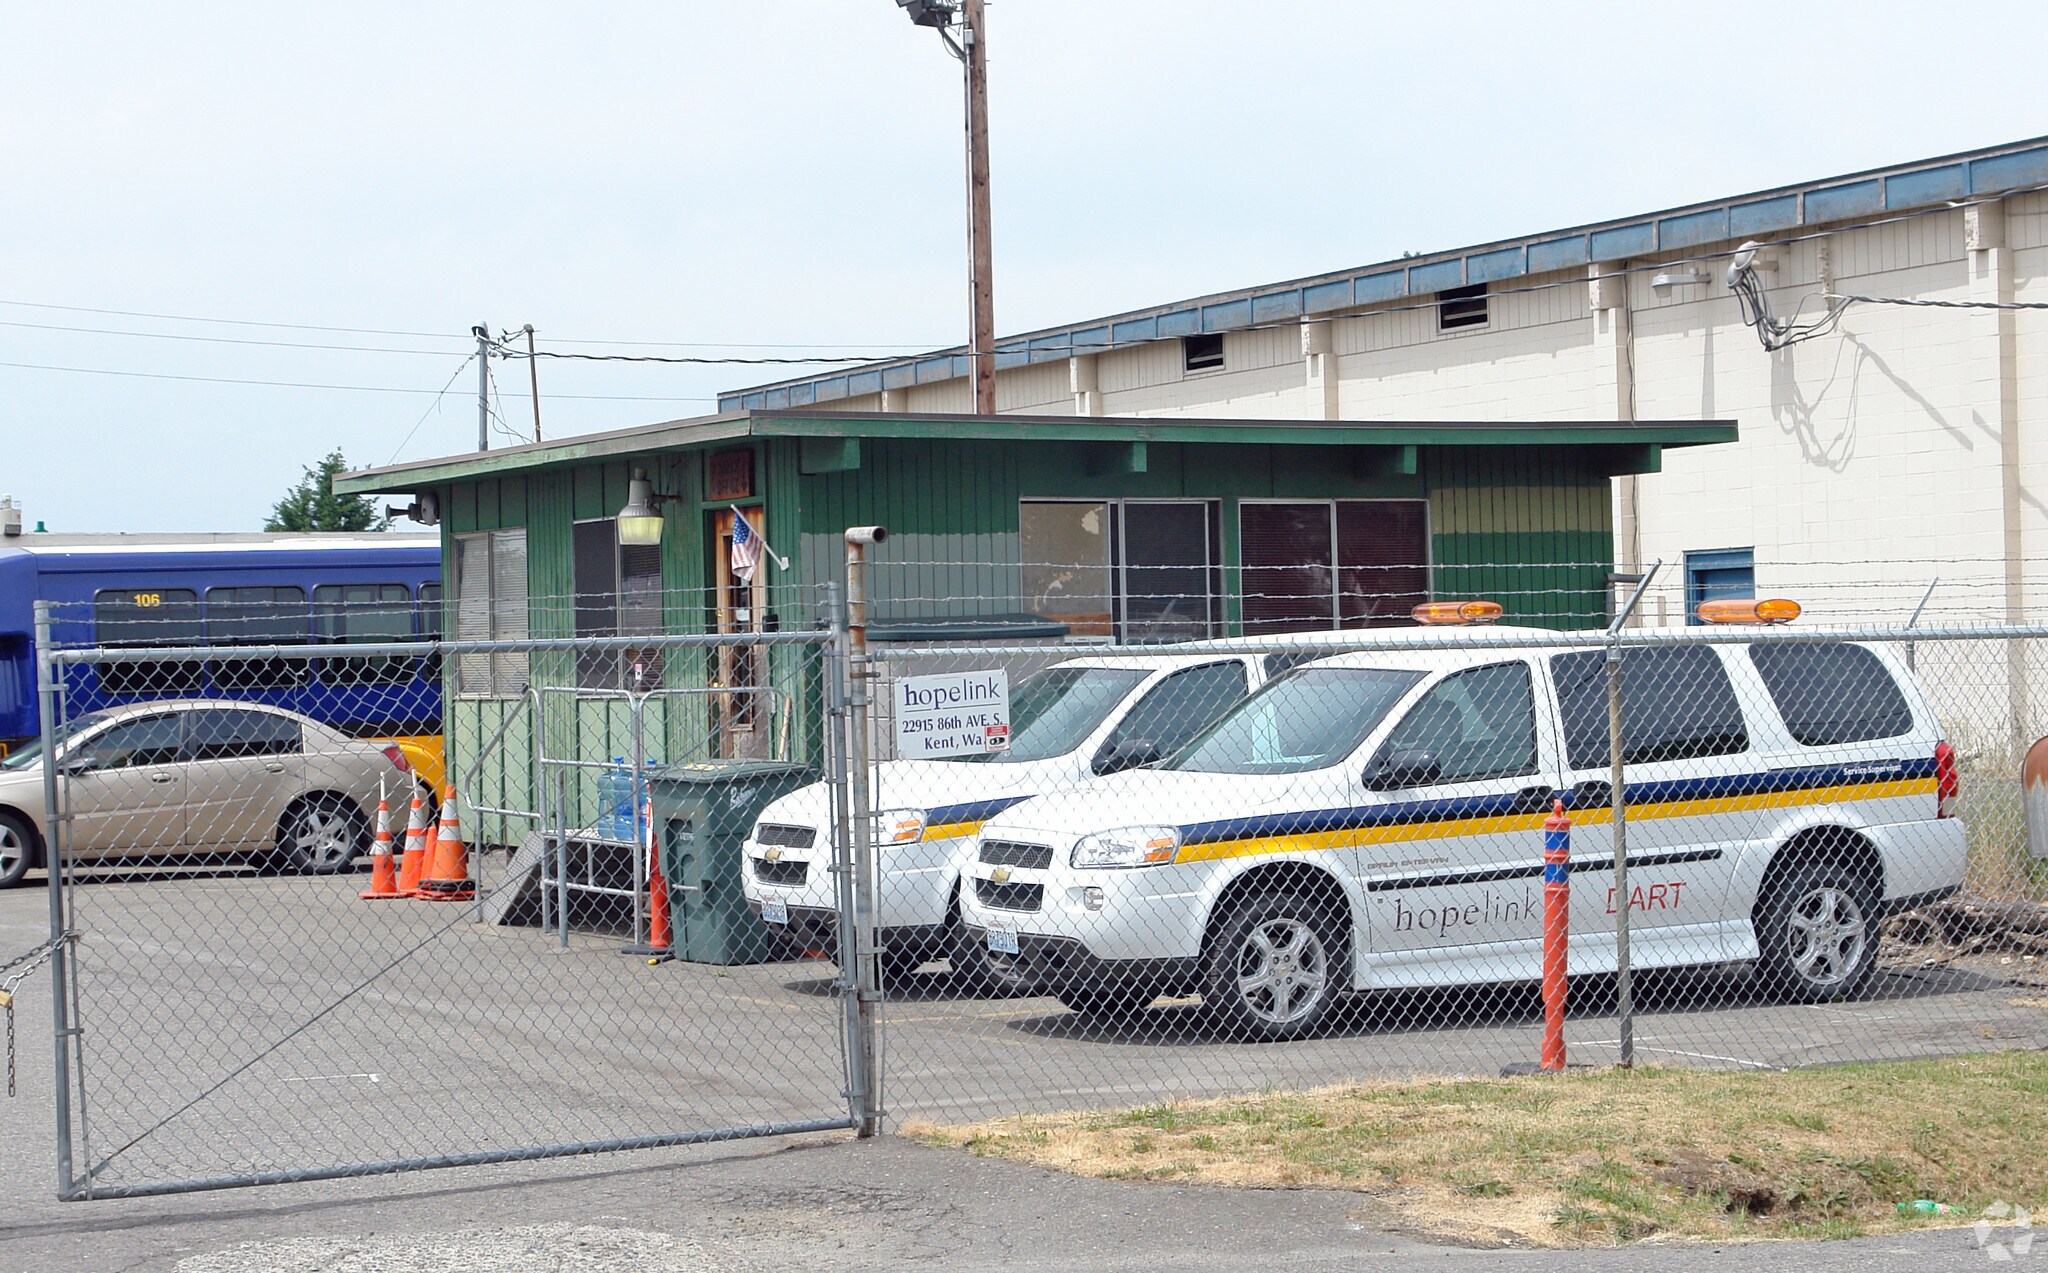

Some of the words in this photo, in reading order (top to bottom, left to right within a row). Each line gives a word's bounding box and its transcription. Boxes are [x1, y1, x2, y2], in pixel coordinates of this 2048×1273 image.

[133, 593, 160, 608] 106
[903, 676, 1001, 710] hopelink
[902, 718, 934, 733] 22915
[937, 716, 962, 731] 86th
[924, 735, 960, 750] Kent,
[1393, 886, 1537, 938] hopelink
